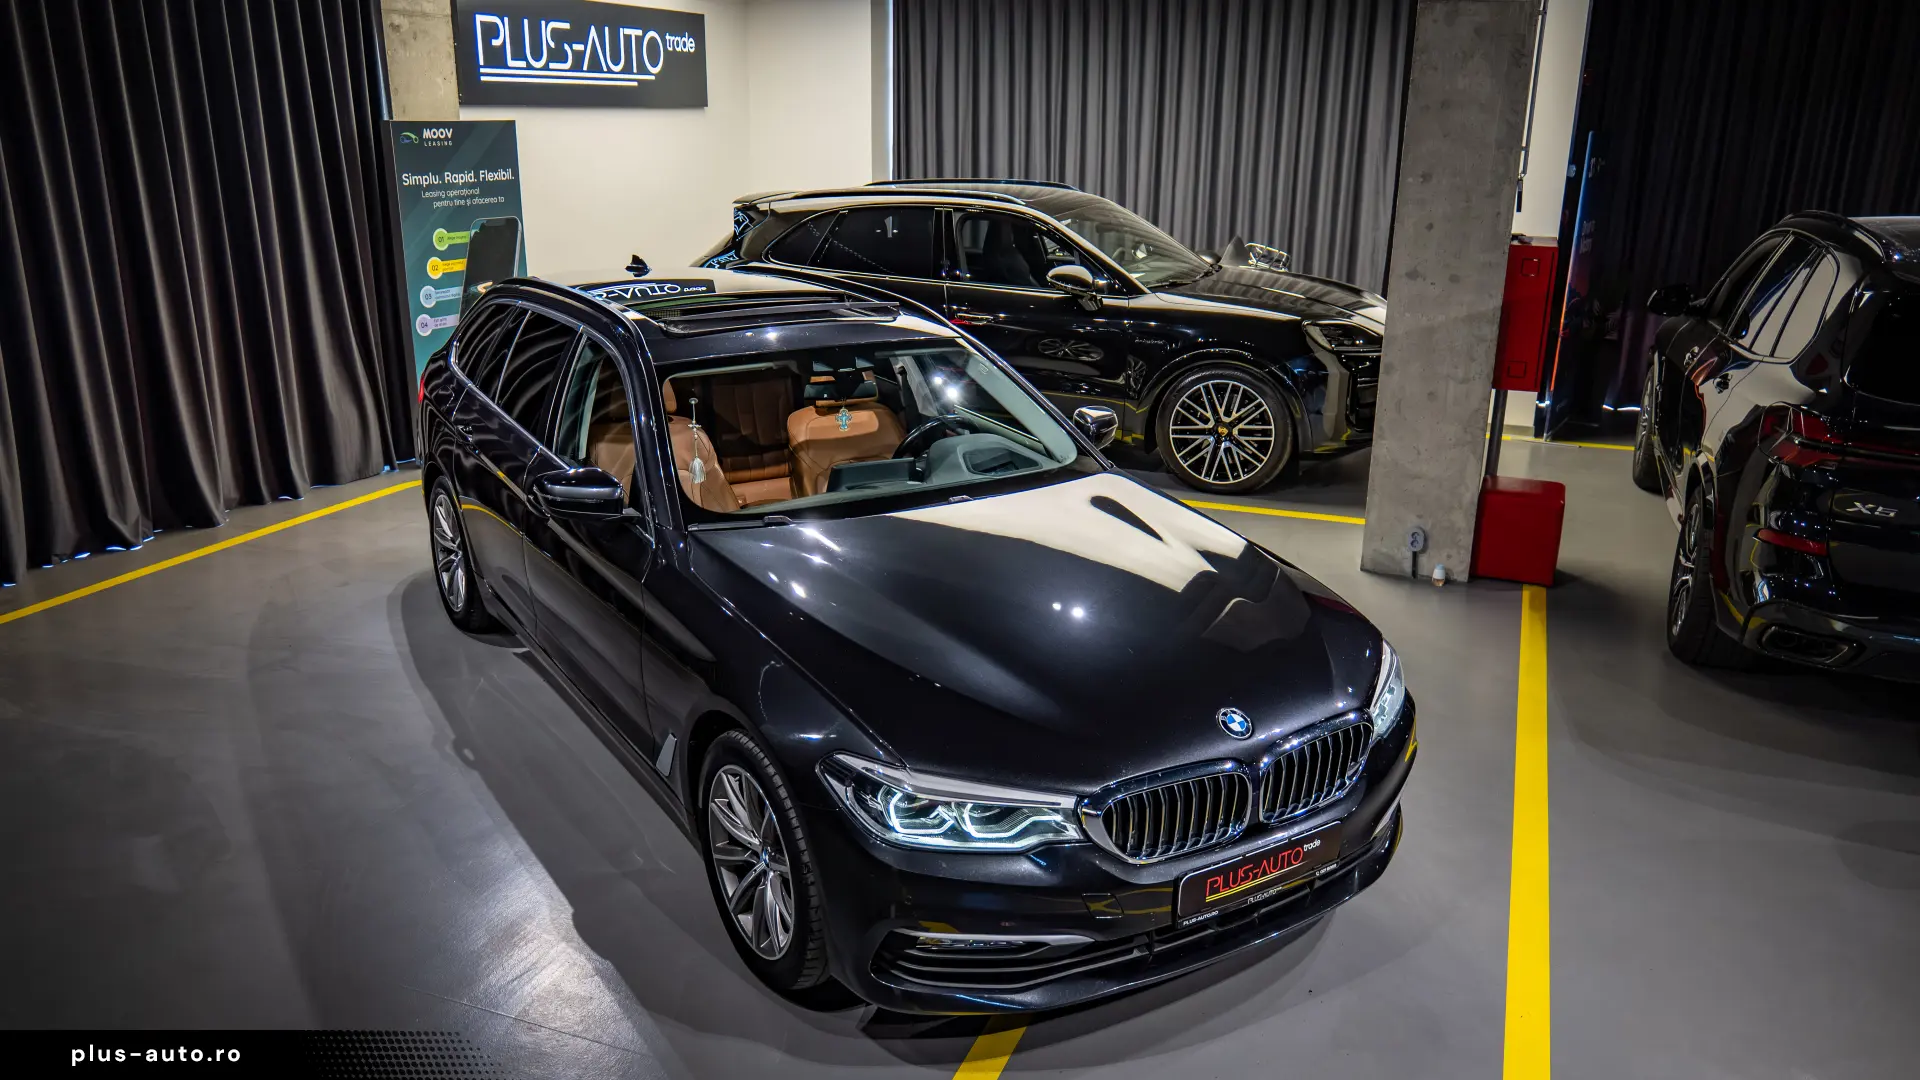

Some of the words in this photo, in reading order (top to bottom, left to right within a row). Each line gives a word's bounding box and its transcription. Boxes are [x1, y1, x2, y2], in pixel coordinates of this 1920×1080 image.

[475, 13, 664, 75] PLUS-AUTO
[665, 32, 696, 53] trade
[422, 128, 453, 139] MOOV
[401, 172, 442, 188] Simplu.
[444, 170, 477, 185] Rapid.
[479, 168, 515, 182] Flexibil.
[421, 190, 446, 199] Leasing
[433, 200, 454, 209] pentru
[454, 198, 465, 206] tine
[472, 197, 498, 205] afacerea
[1845, 501, 1899, 517] X5
[1206, 847, 1303, 896] PLUS-AUTO
[1303, 838, 1321, 852] trade
